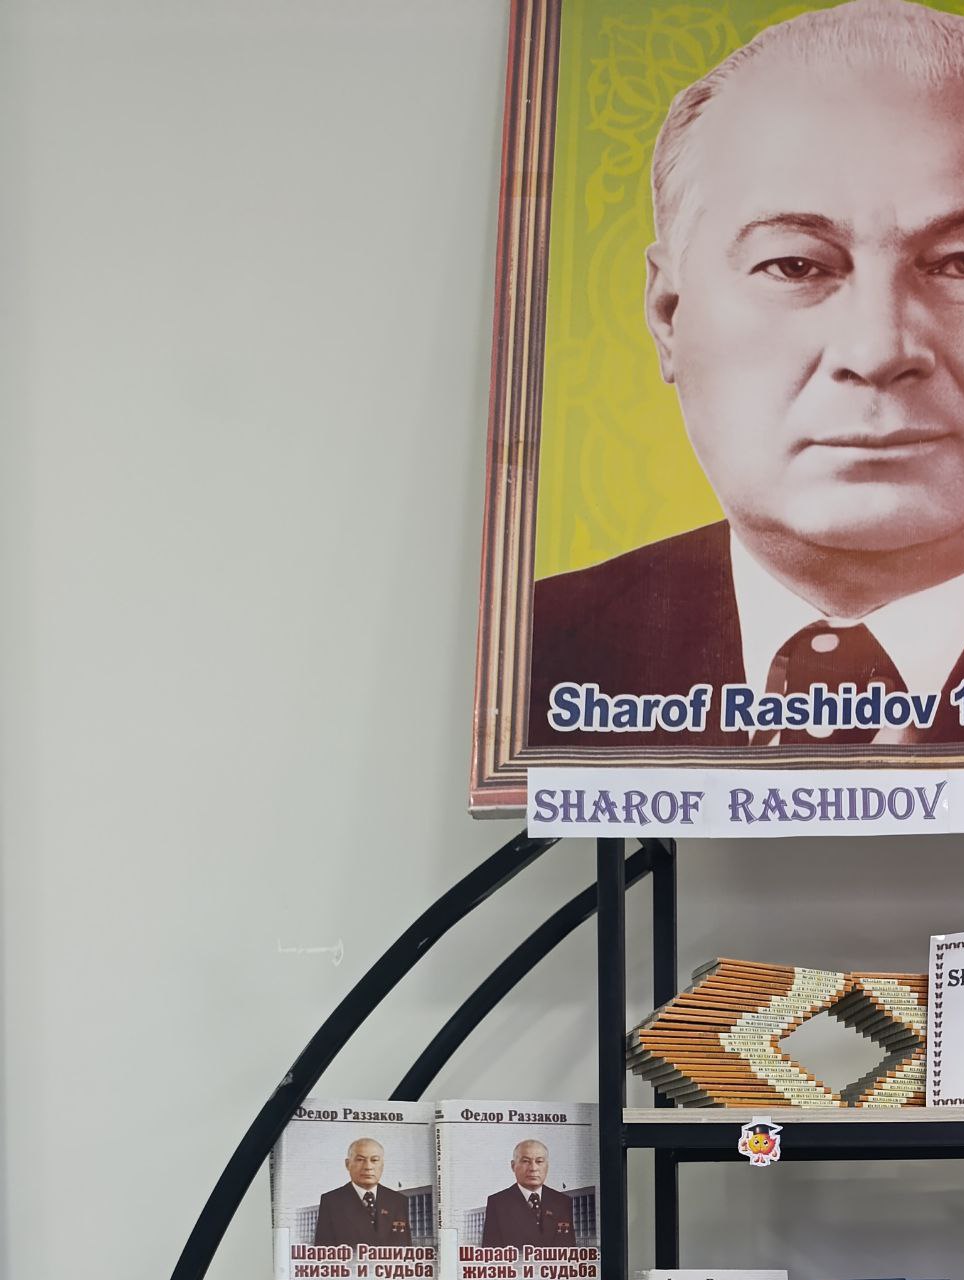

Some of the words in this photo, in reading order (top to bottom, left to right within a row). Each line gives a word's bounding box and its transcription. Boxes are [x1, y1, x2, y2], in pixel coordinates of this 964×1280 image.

[552, 685, 708, 729] Sharof
[725, 685, 936, 729] Rashidov
[533, 788, 705, 825] SHAROF
[729, 781, 946, 823] RASHIDOV
[294, 1107, 337, 1122] Федор
[343, 1108, 403, 1122] Раззаков
[461, 1109, 503, 1123] Федор
[508, 1109, 567, 1123] Раззаков
[291, 1244, 353, 1262] Шараф
[459, 1246, 517, 1263] Шараф
[295, 1265, 350, 1279] жизнь
[358, 1265, 368, 1278] и
[375, 1264, 433, 1279] судьба
[463, 1266, 516, 1279] жизнь
[523, 1266, 533, 1279] и
[541, 1265, 596, 1280] судьба
